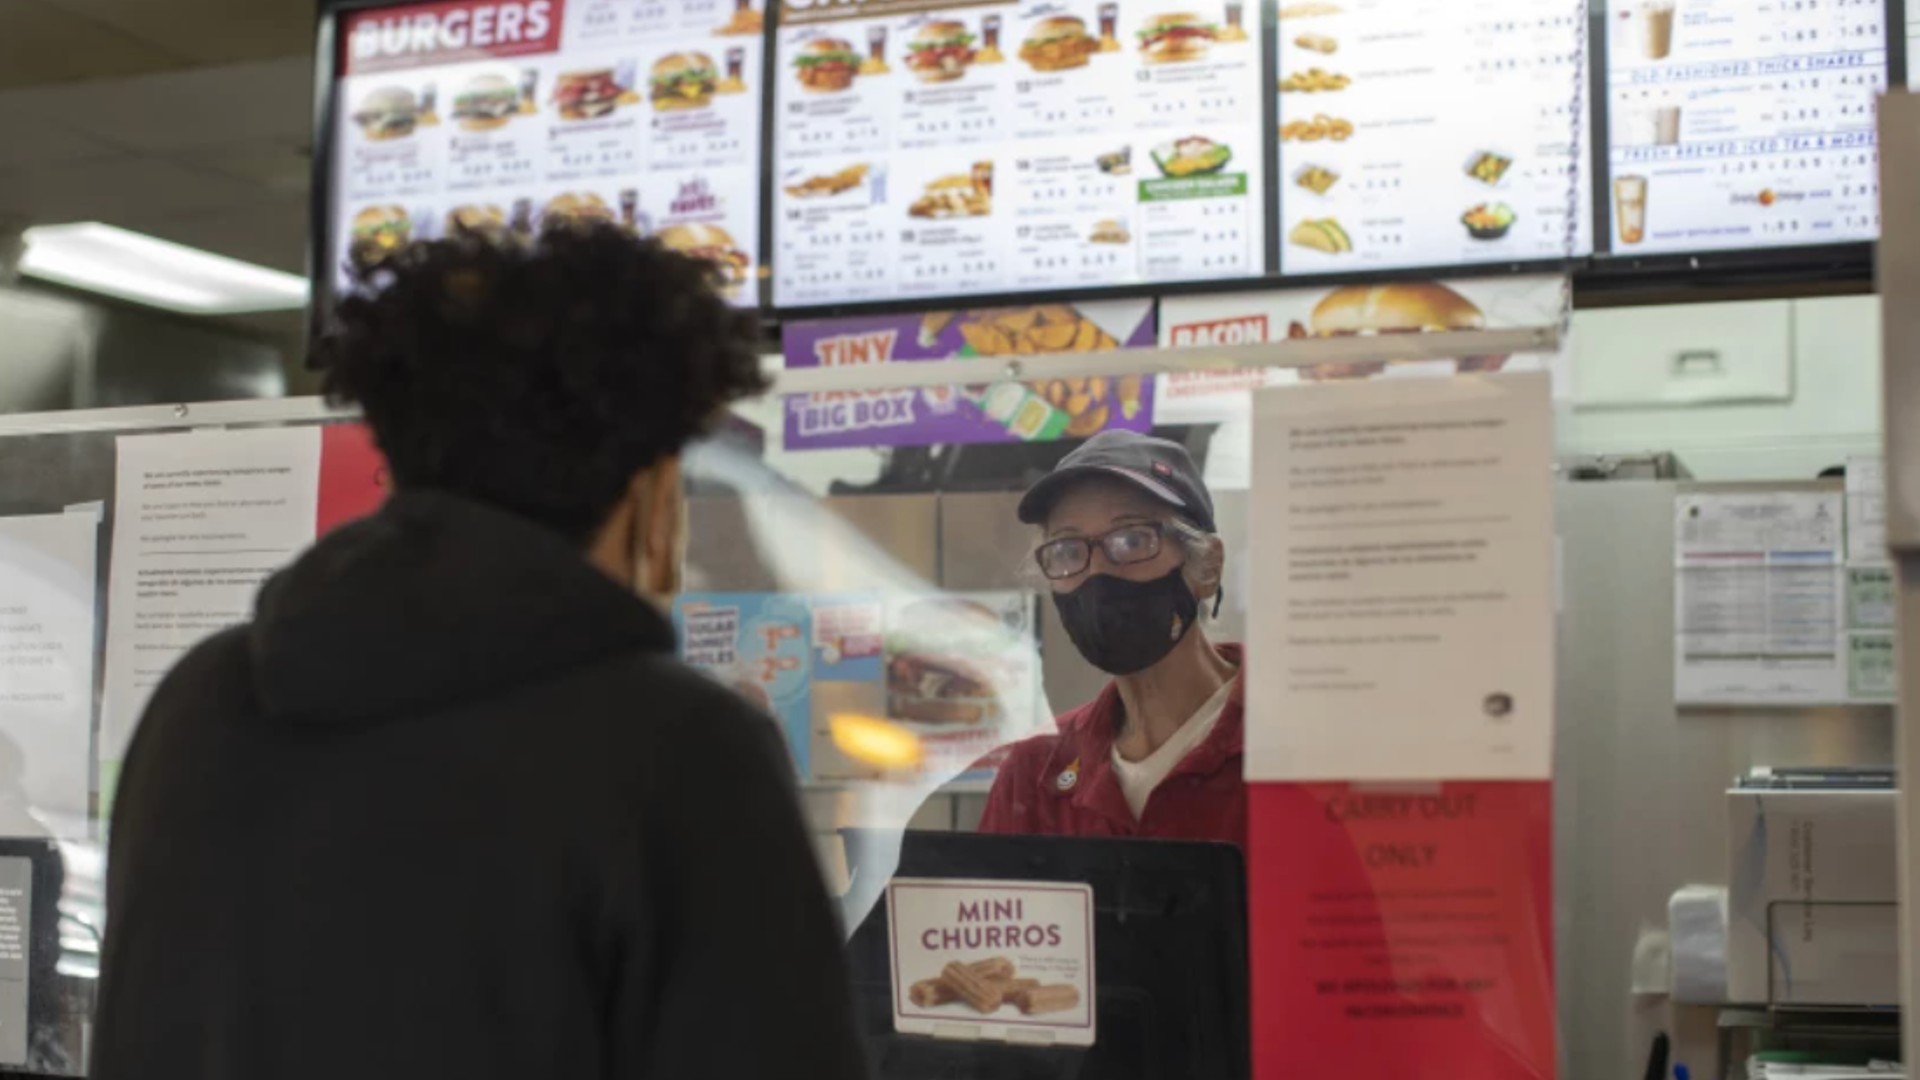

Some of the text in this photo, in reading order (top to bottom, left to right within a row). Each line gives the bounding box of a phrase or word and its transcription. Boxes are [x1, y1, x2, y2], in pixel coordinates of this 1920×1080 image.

[353, 0, 552, 59] BURGERS
[1806, 53, 1865, 68] SHAKES
[1744, 139, 1776, 152] ICED
[1784, 137, 1809, 150] TEA
[1175, 318, 1263, 347] BACON
[820, 333, 893, 367] TINY
[804, 397, 908, 431] BIG BOX
[687, 618, 737, 634] SUGAR
[1325, 791, 1477, 824] CARRY OUT
[1365, 842, 1438, 869] ONLY
[958, 898, 1023, 922] MINI
[921, 924, 1062, 950] CHURROS
